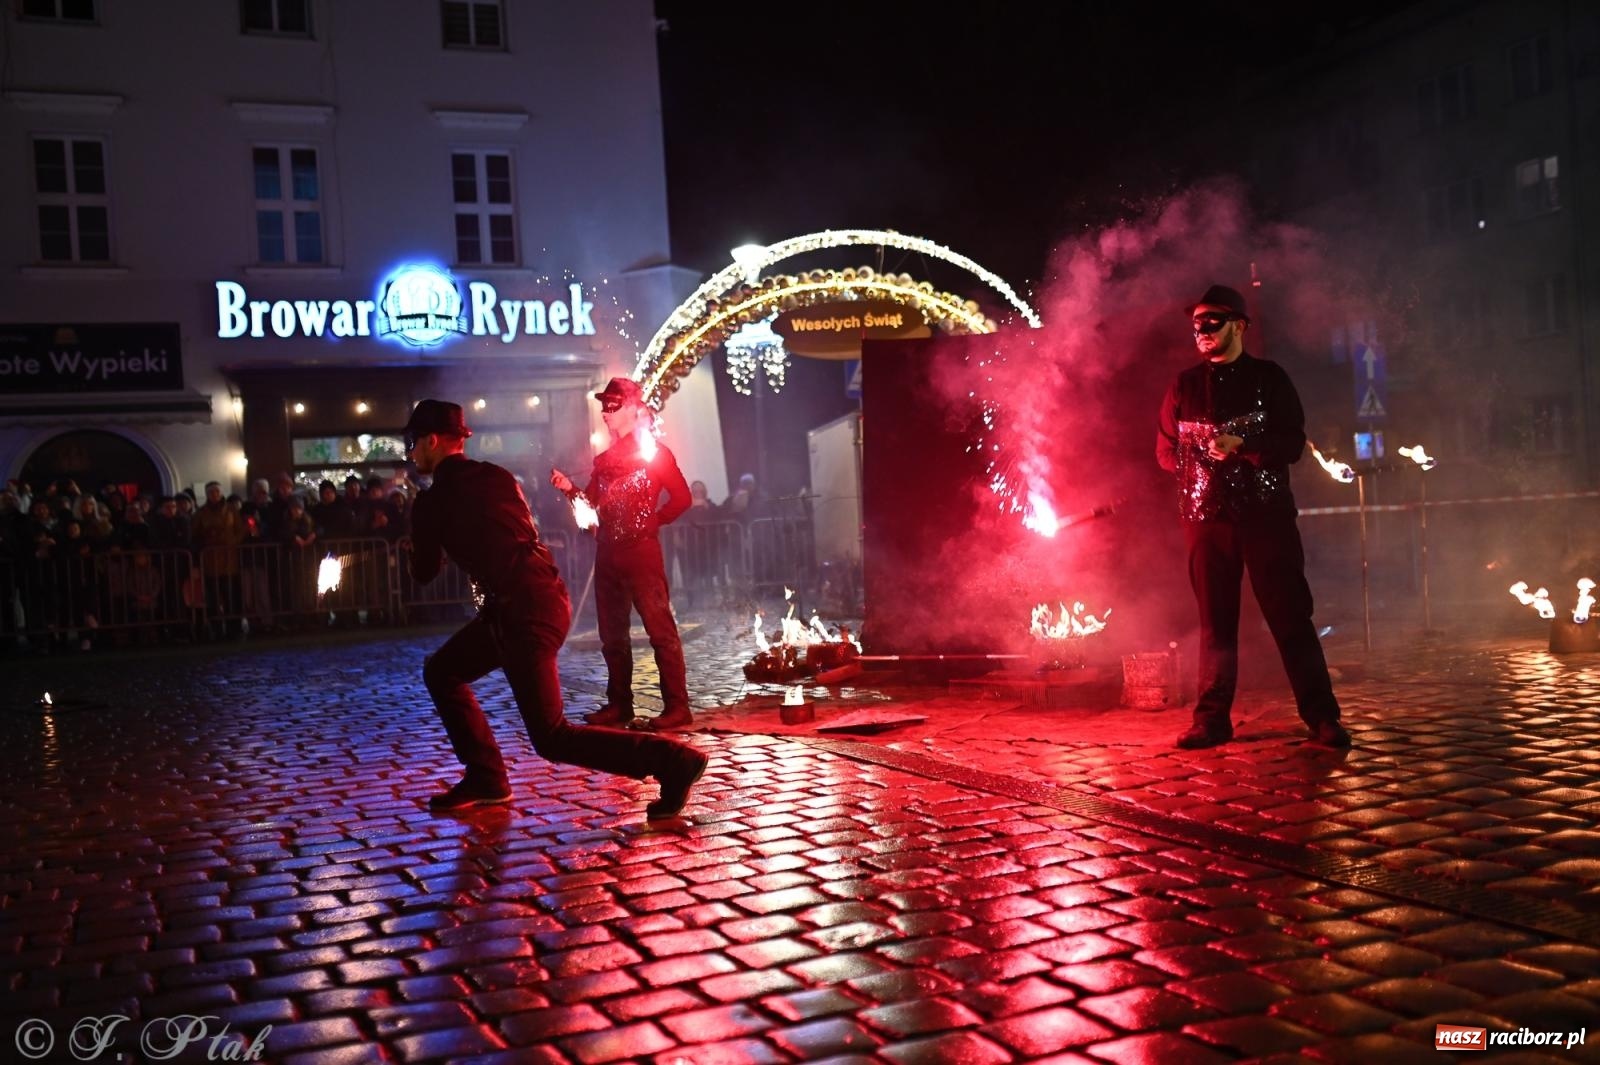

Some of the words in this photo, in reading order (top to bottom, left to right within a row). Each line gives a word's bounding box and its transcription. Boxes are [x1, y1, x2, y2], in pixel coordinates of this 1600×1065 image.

[215, 281, 375, 338] Browar
[469, 282, 596, 343] Rynek
[864, 312, 903, 328] Świąt
[48, 348, 168, 379] Wypieki
